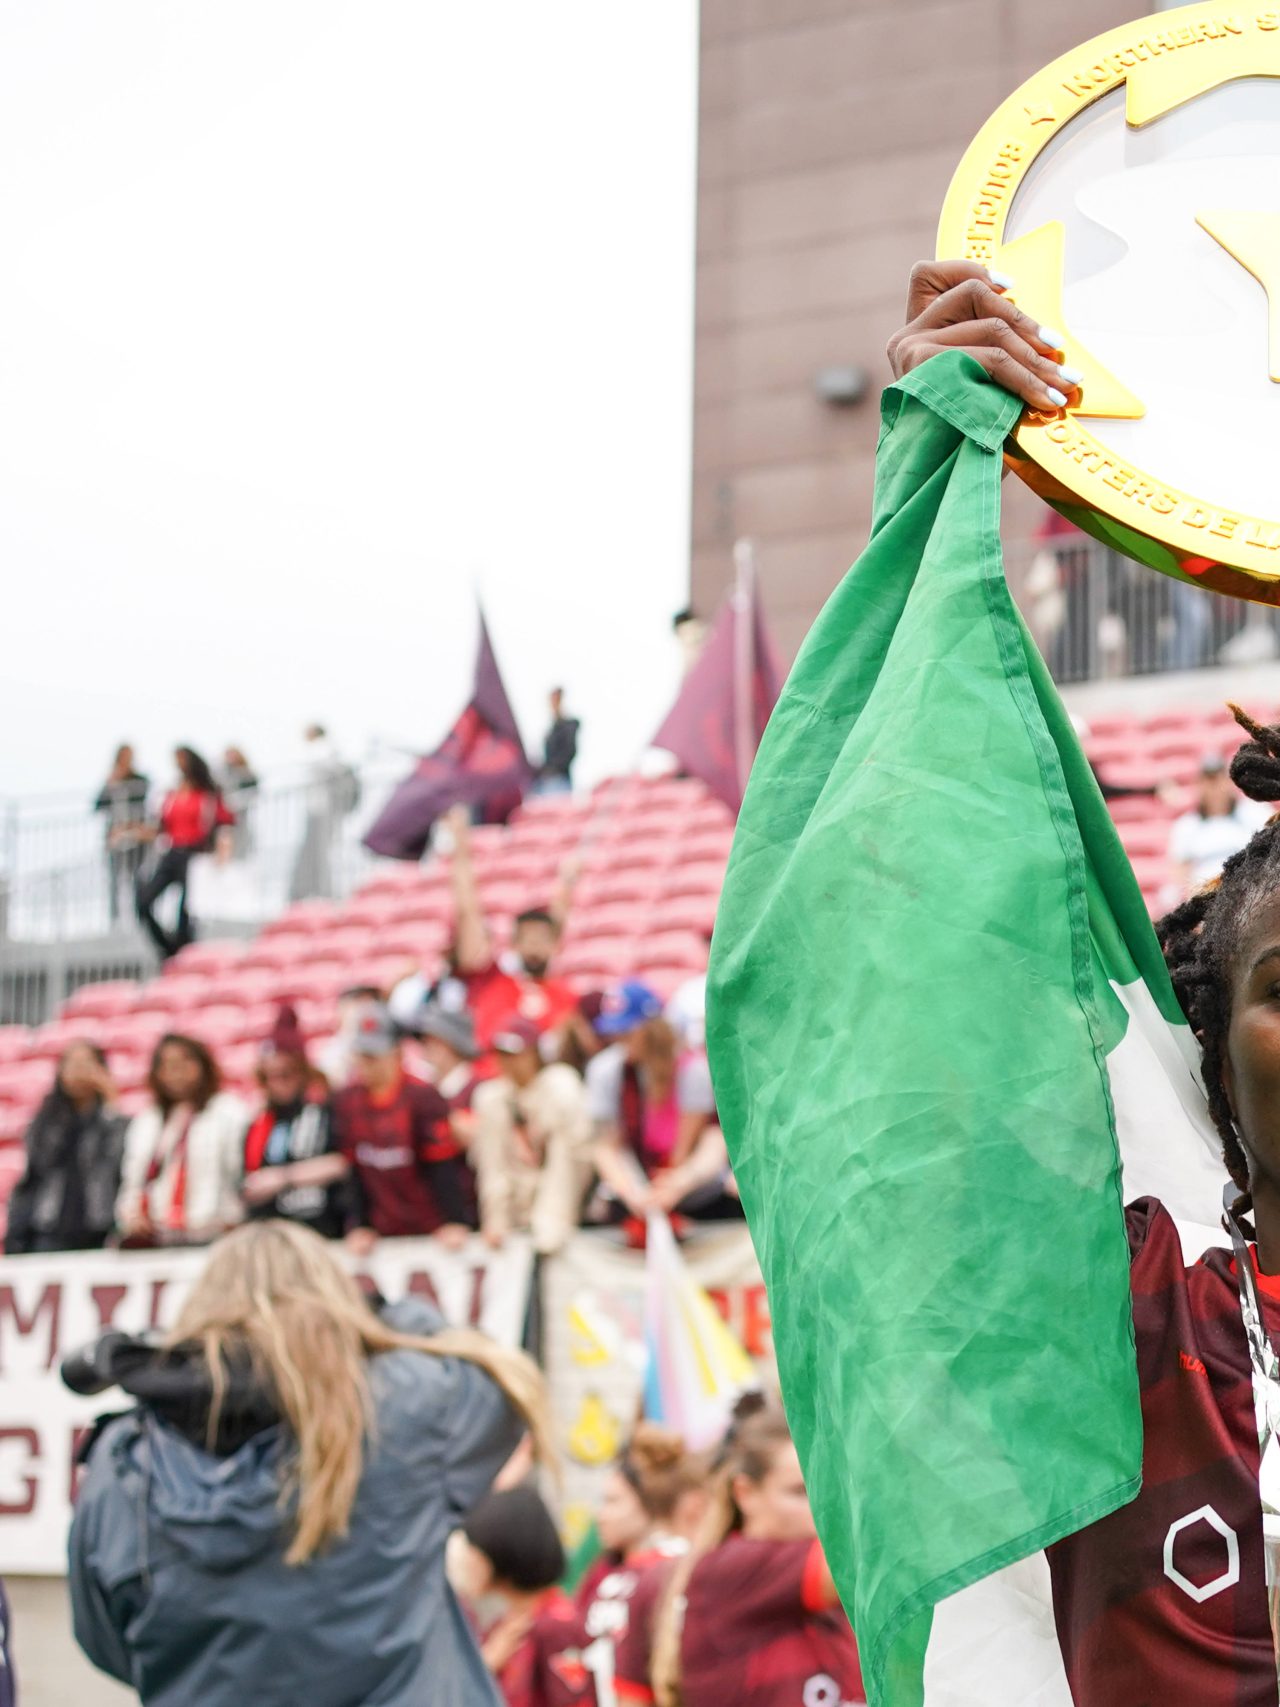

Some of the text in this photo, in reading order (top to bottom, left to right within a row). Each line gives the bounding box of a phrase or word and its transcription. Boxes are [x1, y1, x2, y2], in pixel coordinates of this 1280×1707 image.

[1061, 14, 1244, 98] NORTHERN
[963, 141, 1026, 264] BOUCLIE
[1044, 421, 1180, 516] ORTERS
[1181, 504, 1242, 541] DE
